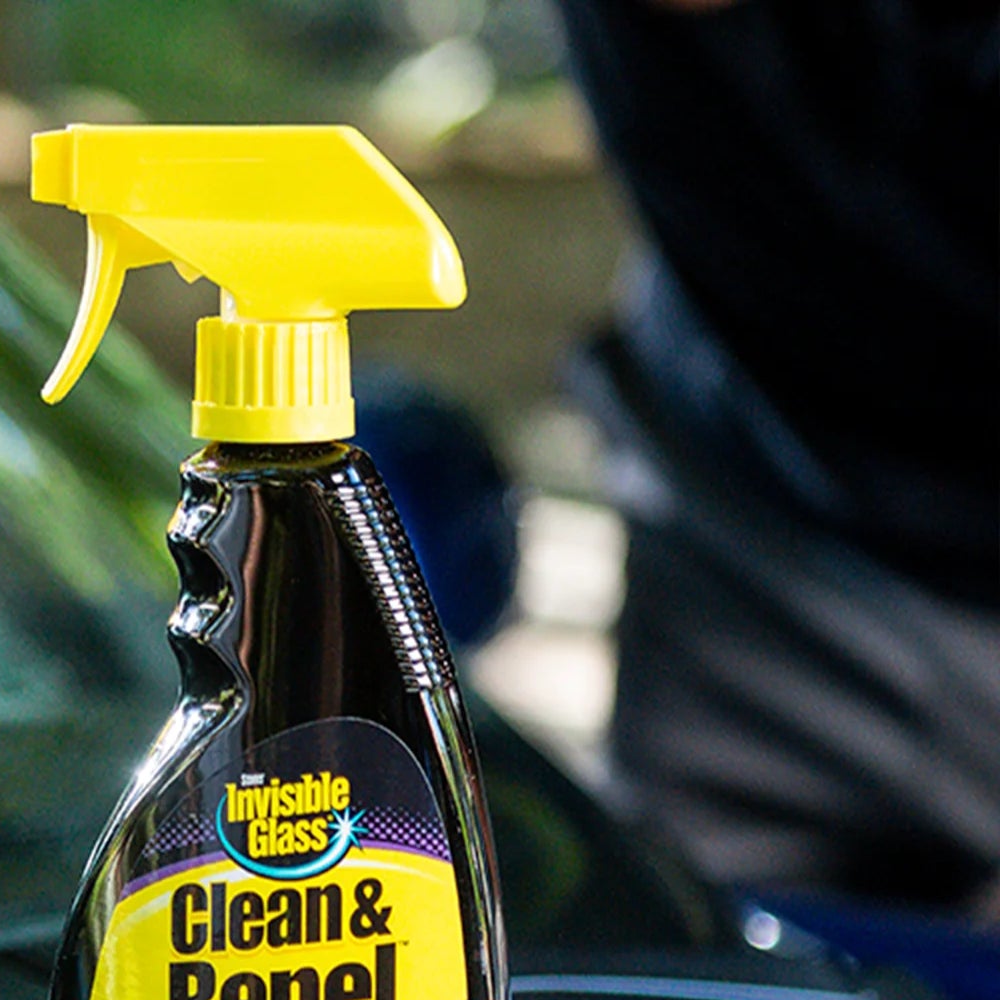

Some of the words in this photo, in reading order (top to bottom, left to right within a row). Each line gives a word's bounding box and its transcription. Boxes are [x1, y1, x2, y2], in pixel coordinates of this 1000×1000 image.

[225, 771, 350, 822] Invisible
[248, 817, 328, 858] Glass
[171, 882, 341, 955] Clean
[349, 879, 393, 939] &
